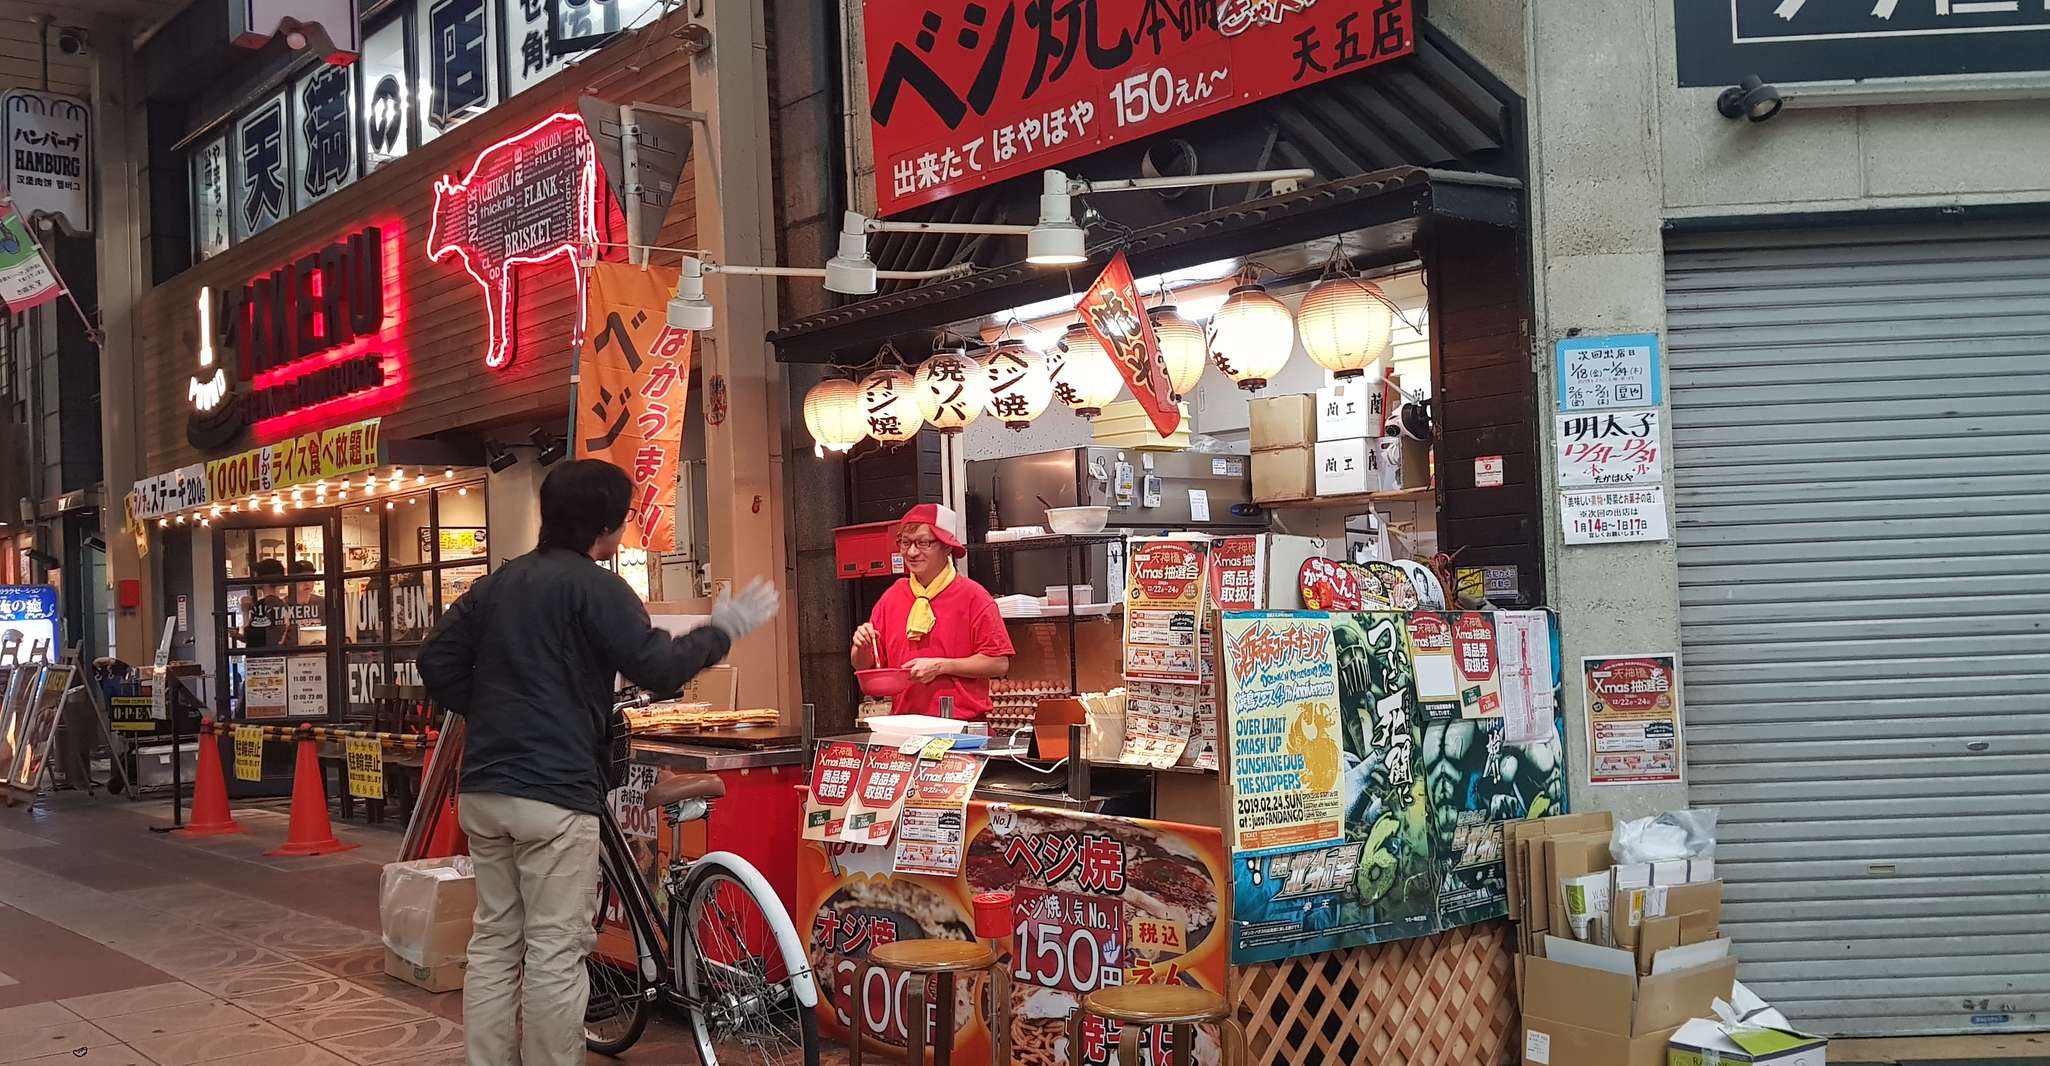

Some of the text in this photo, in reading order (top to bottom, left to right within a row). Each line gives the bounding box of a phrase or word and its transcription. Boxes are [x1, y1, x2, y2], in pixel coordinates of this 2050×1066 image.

[1292, 1, 1405, 82] 天五店
[14, 128, 83, 152] ハンバーグ
[893, 100, 1095, 198] 出来たて ほやほや
[14, 149, 81, 178] HAMBURG
[514, 148, 524, 186] RIB
[534, 146, 563, 167] FILLET
[481, 173, 510, 204] CHUCK
[523, 175, 558, 208] FLANK
[504, 218, 552, 259] BRISKET
[927, 358, 967, 422] 焼ソバ
[1563, 412, 1656, 442] 明太子
[261, 447, 271, 490] しかも
[1134, 561, 1163, 579] Xmas
[1214, 553, 1241, 567] Xmas
[272, 605, 319, 619] TAKERU
[1455, 626, 1473, 640] Xmas
[1594, 678, 1629, 694] Xmas
[1236, 717, 1287, 737] OVER LIMIT
[1236, 736, 1282, 756] SMASH UP
[819, 754, 838, 767] Xmas
[867, 756, 888, 770] Xmas
[1236, 754, 1305, 775] SUNSHINE DUB
[821, 770, 851, 784] 商品券
[870, 773, 901, 786] 商品券
[915, 767, 942, 782] Xmas
[1236, 773, 1302, 795] THE SKIPPERS
[818, 784, 848, 799] 取扱店
[864, 787, 895, 801] 取扱店
[1265, 810, 1304, 826] FANDANGO
[1004, 834, 1124, 892] ベジ焼
[1138, 922, 1180, 946] 税込
